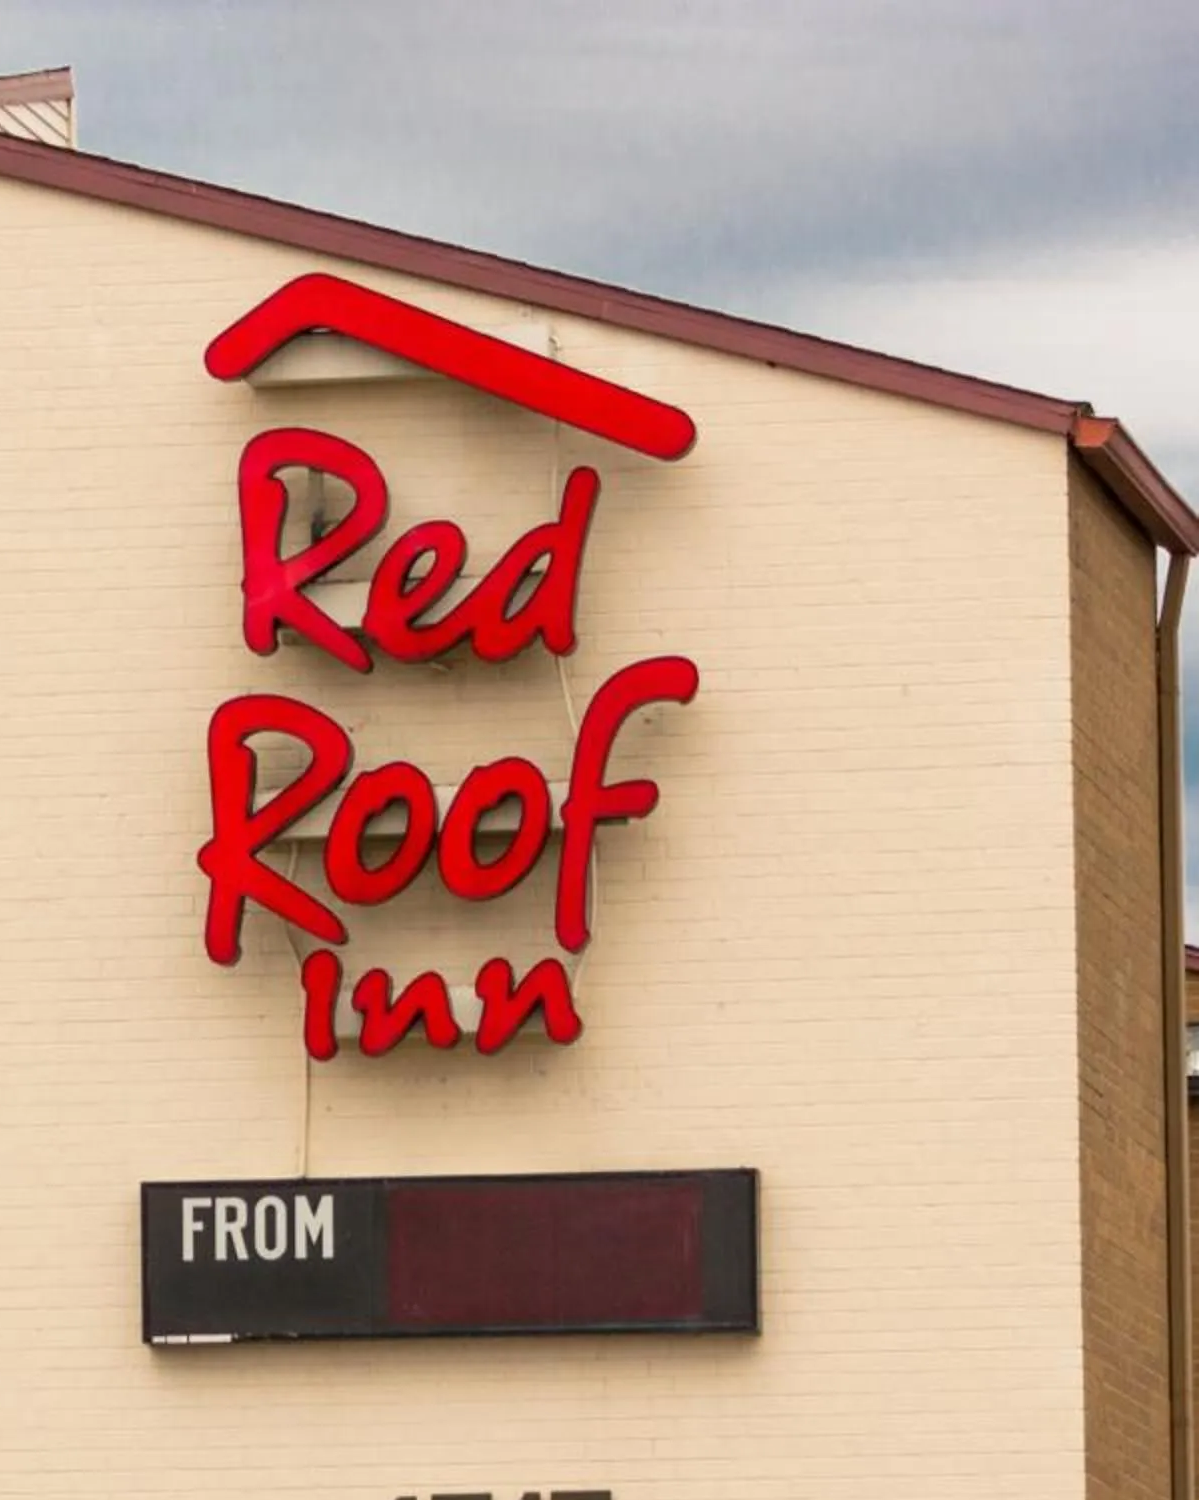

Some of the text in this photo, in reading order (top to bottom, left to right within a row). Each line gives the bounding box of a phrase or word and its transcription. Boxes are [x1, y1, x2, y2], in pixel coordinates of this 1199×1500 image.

[239, 427, 599, 672] Red
[197, 656, 699, 966] Roof
[181, 1195, 335, 1262] FROM
